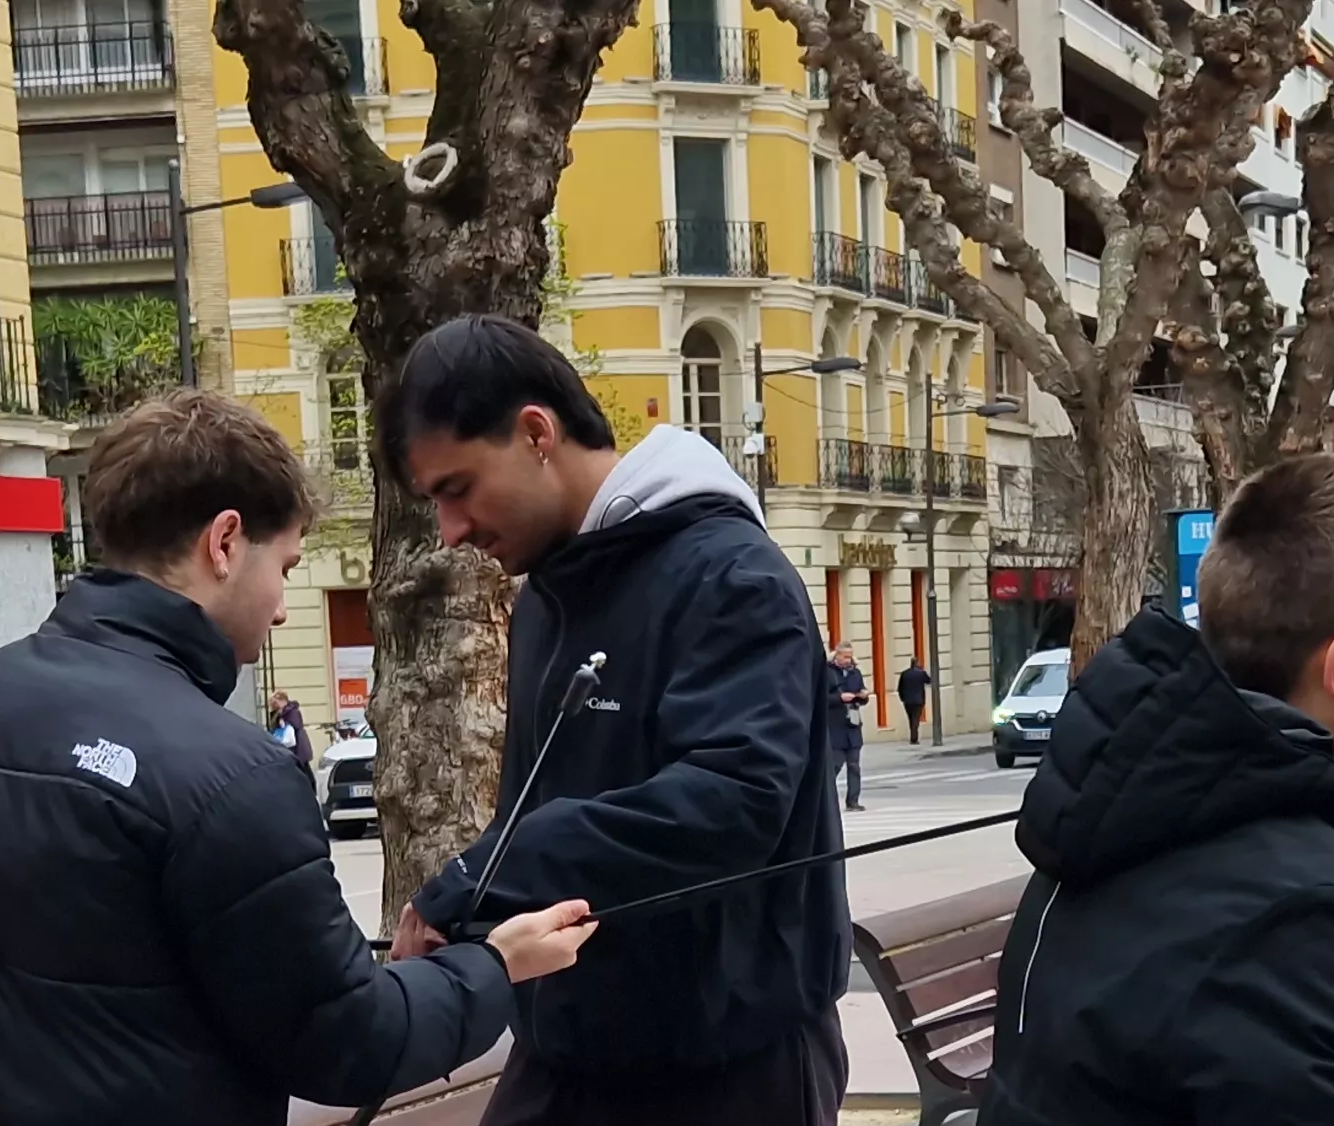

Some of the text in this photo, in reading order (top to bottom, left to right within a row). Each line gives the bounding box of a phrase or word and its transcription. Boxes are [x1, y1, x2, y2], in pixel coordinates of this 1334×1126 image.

[72, 743, 120, 767] NORTH
[98, 737, 123, 755] THE
[76, 756, 112, 775] FACE
